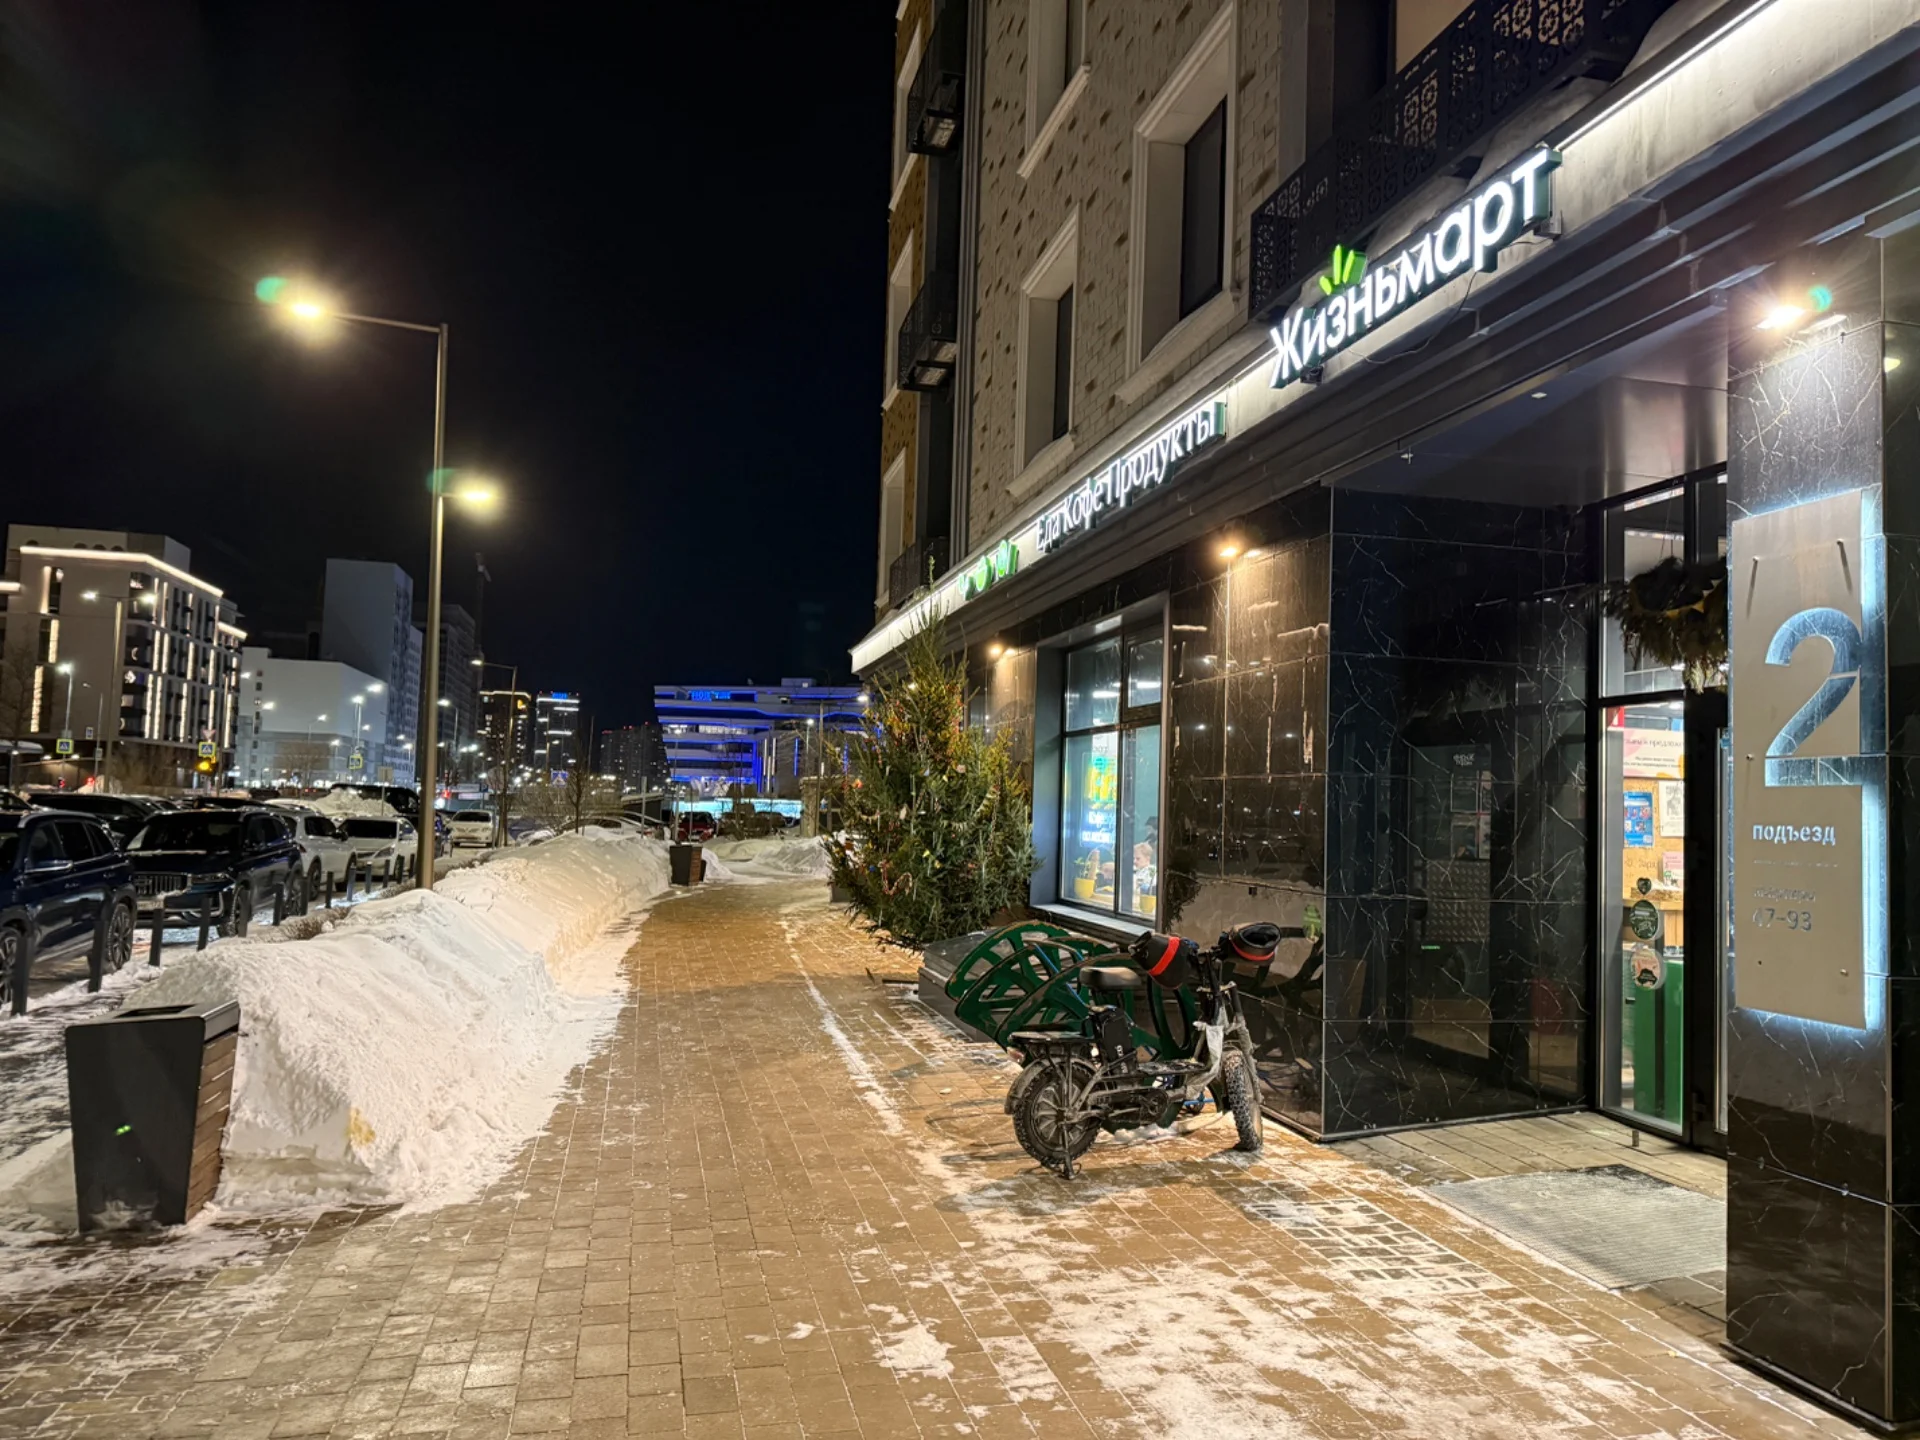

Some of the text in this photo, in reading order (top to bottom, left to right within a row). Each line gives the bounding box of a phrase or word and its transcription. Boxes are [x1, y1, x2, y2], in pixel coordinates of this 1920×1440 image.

[1269, 147, 1555, 389] Жизньмарт
[1036, 402, 1218, 552] Еда Кофе Продукты
[1764, 607, 1863, 787] 2
[1752, 824, 1836, 846] подъезд
[1752, 907, 1812, 932] 47-93
